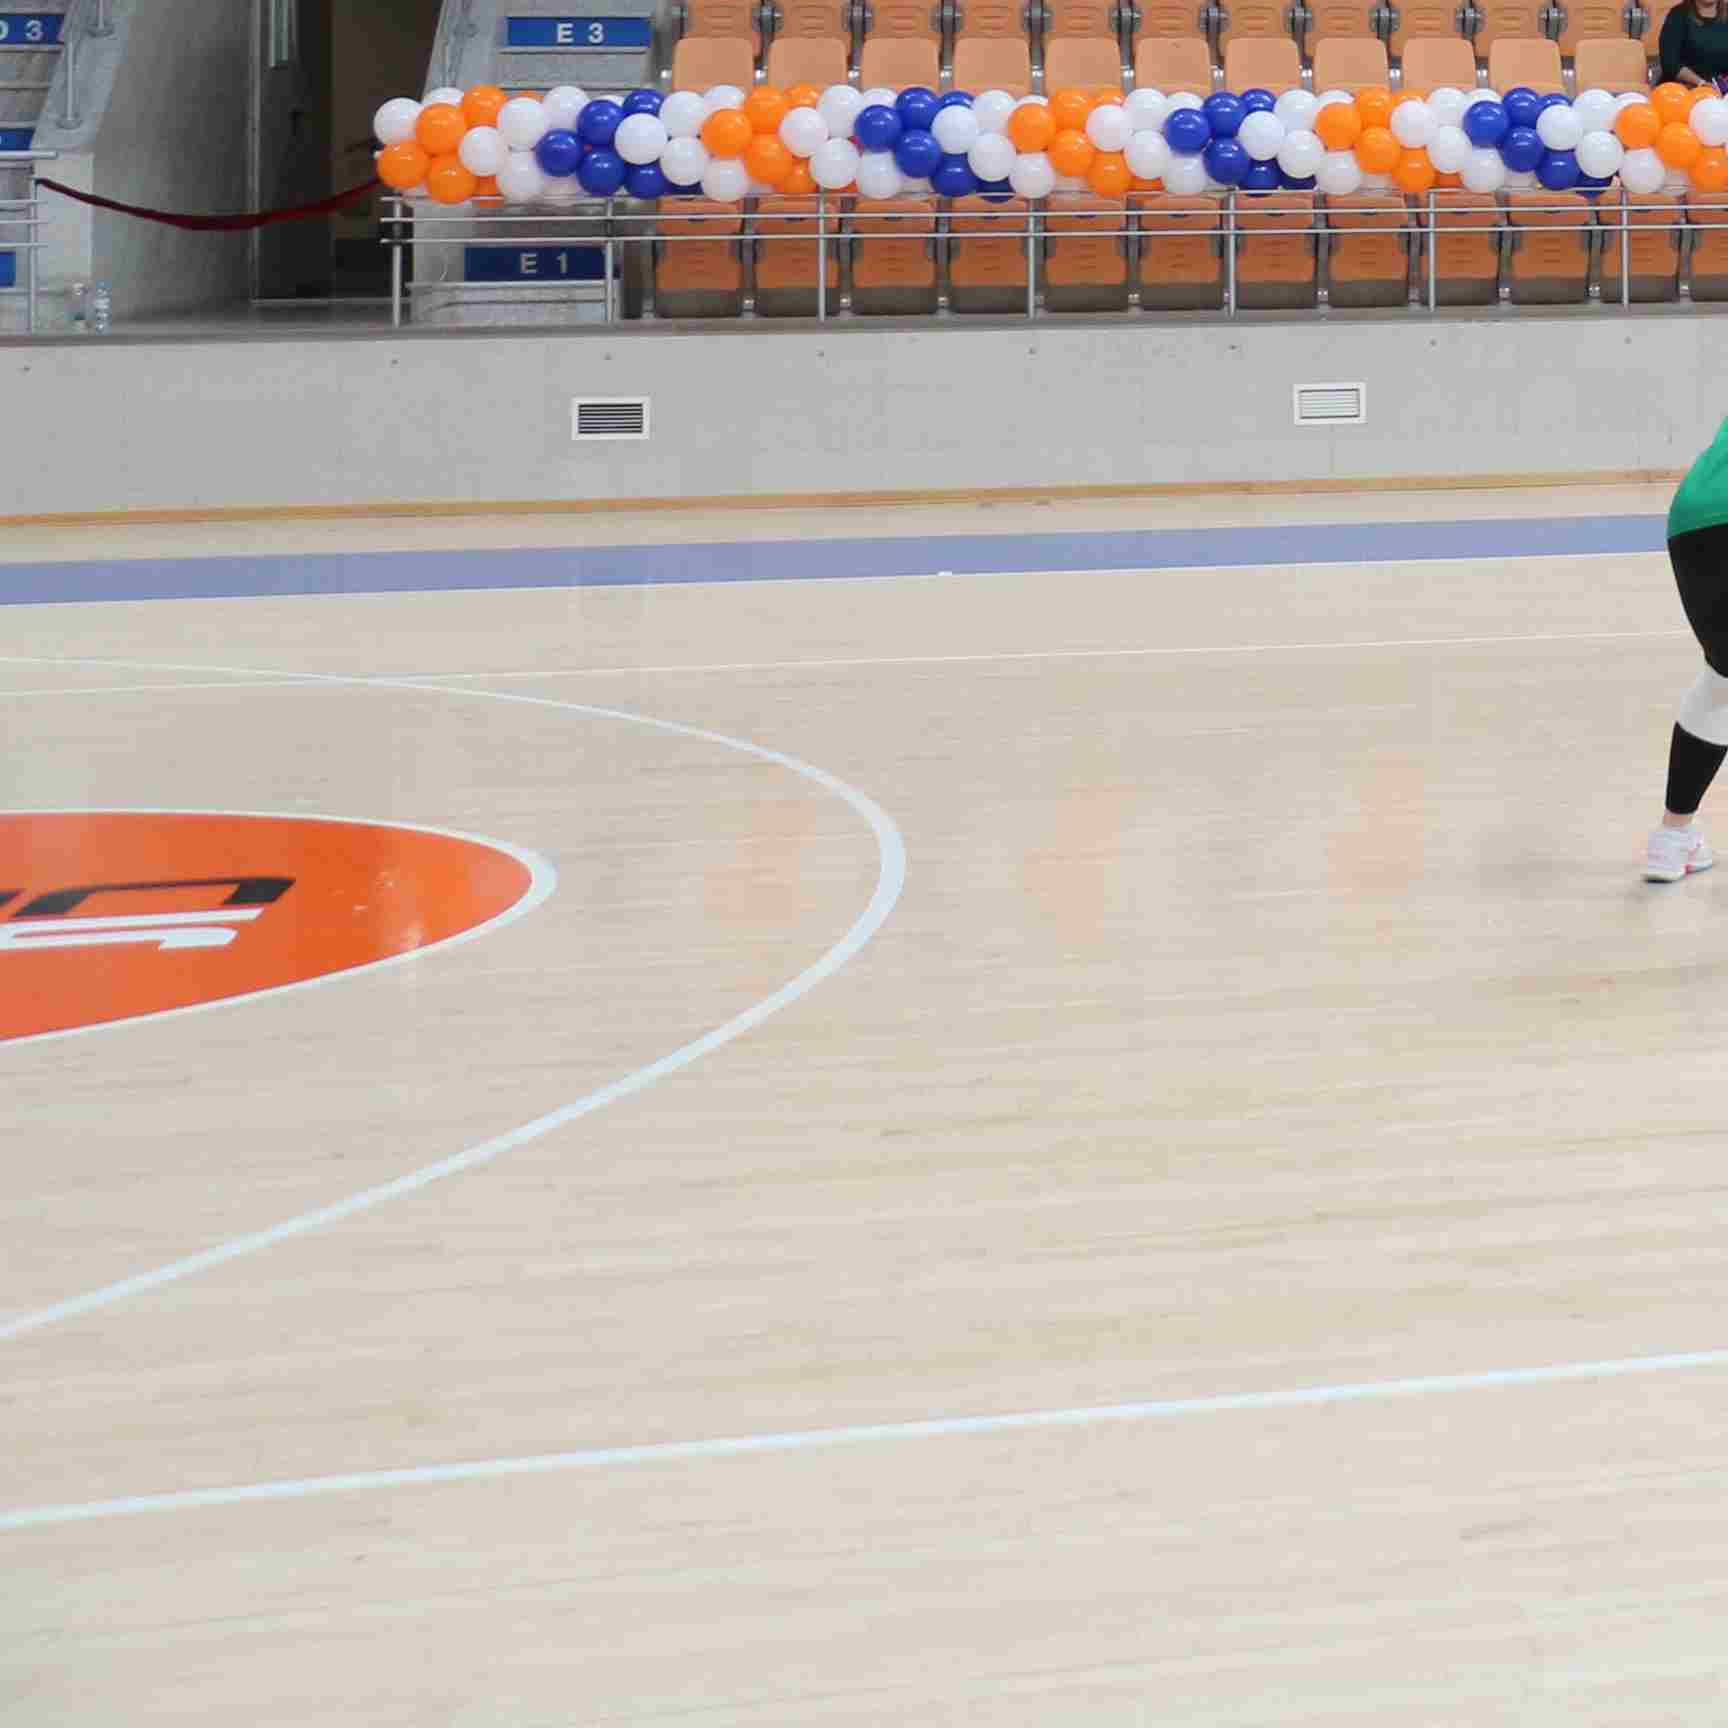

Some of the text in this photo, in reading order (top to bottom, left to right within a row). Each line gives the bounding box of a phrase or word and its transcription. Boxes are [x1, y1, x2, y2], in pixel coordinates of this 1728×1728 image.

[25, 19, 43, 41] 3
[556, 23, 605, 43] E 3
[520, 251, 568, 274] E 1
